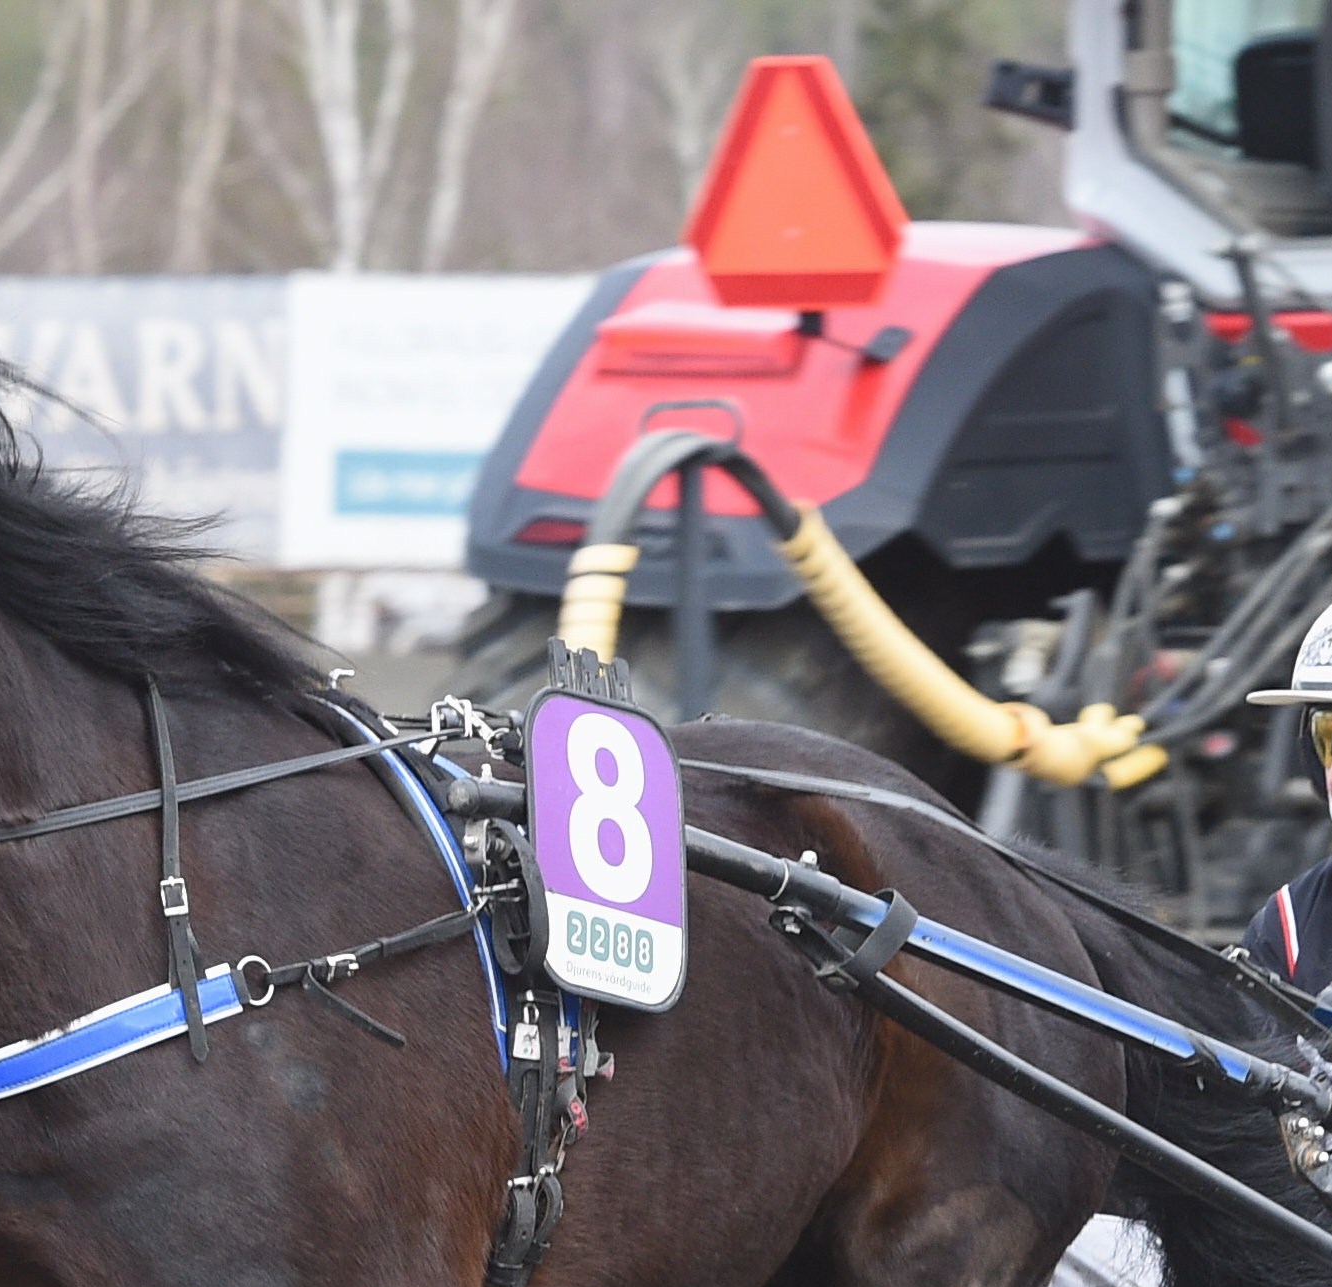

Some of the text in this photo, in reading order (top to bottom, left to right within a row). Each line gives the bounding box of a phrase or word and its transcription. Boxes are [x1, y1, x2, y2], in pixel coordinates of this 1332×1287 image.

[567, 712, 652, 903] 8
[569, 916, 652, 968] 2288
[566, 960, 652, 994] Djurens vårdguide
